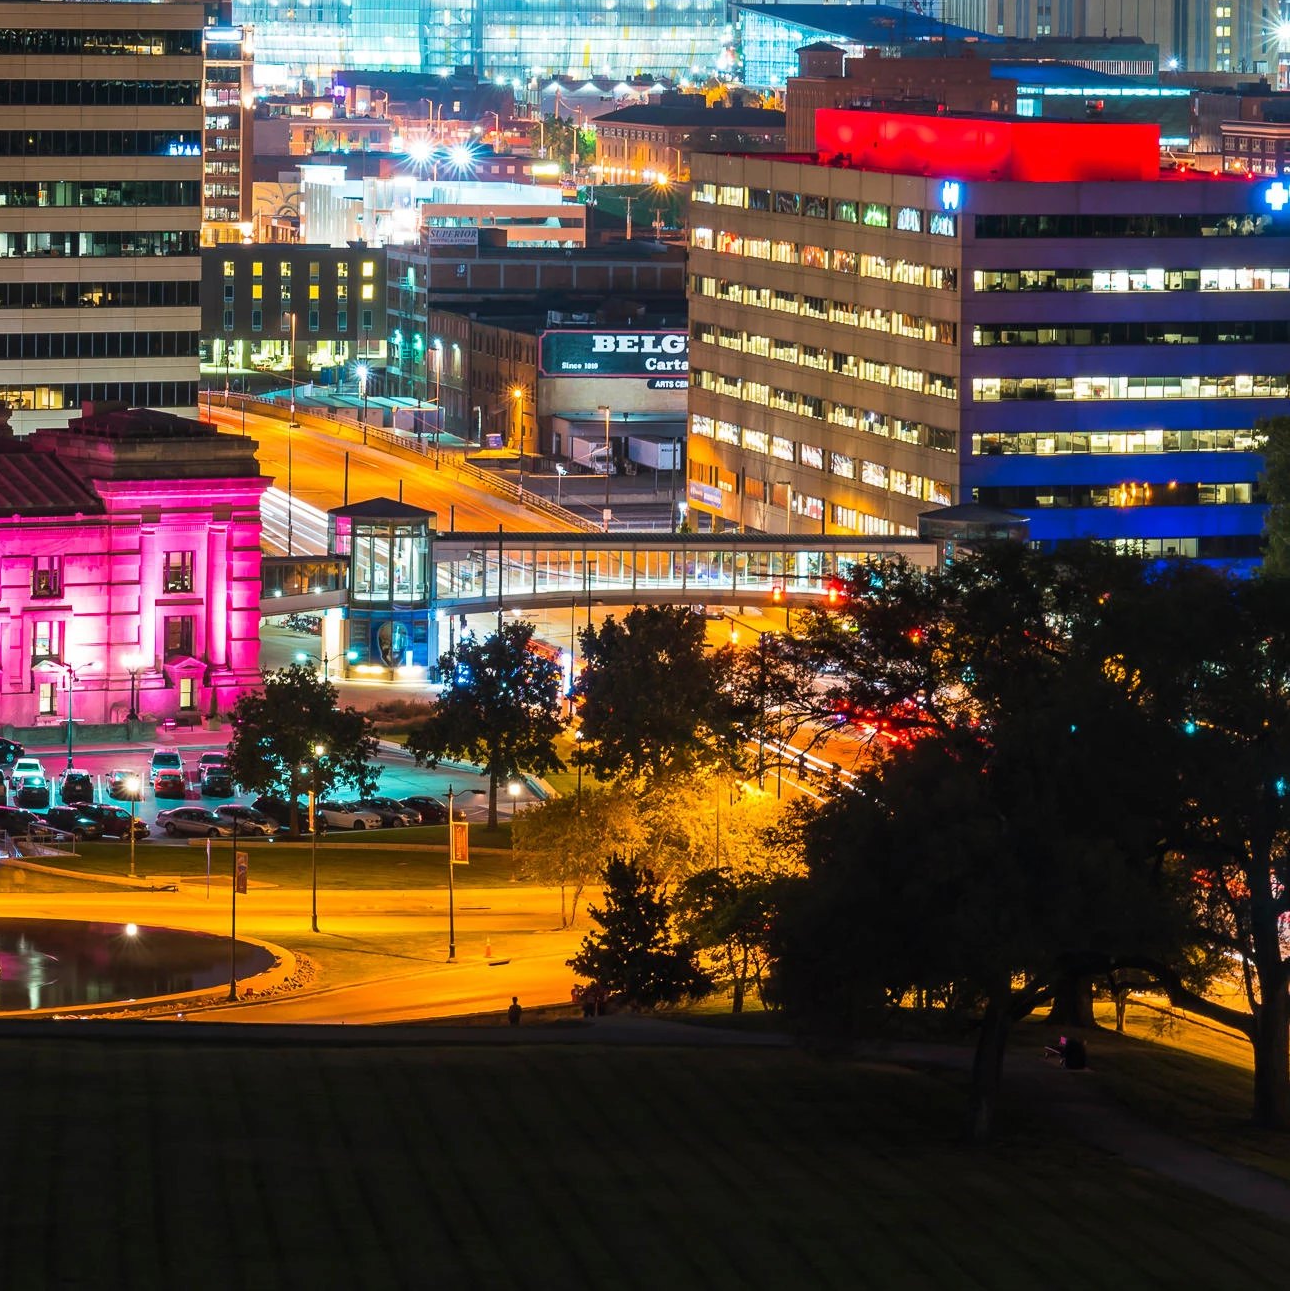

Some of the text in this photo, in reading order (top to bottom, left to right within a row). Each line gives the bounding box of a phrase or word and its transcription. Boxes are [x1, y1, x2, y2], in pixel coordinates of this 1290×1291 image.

[430, 229, 477, 238] SUPERIOR
[591, 334, 689, 354] BELG
[561, 361, 582, 370] Since
[655, 380, 674, 388] ARTS
